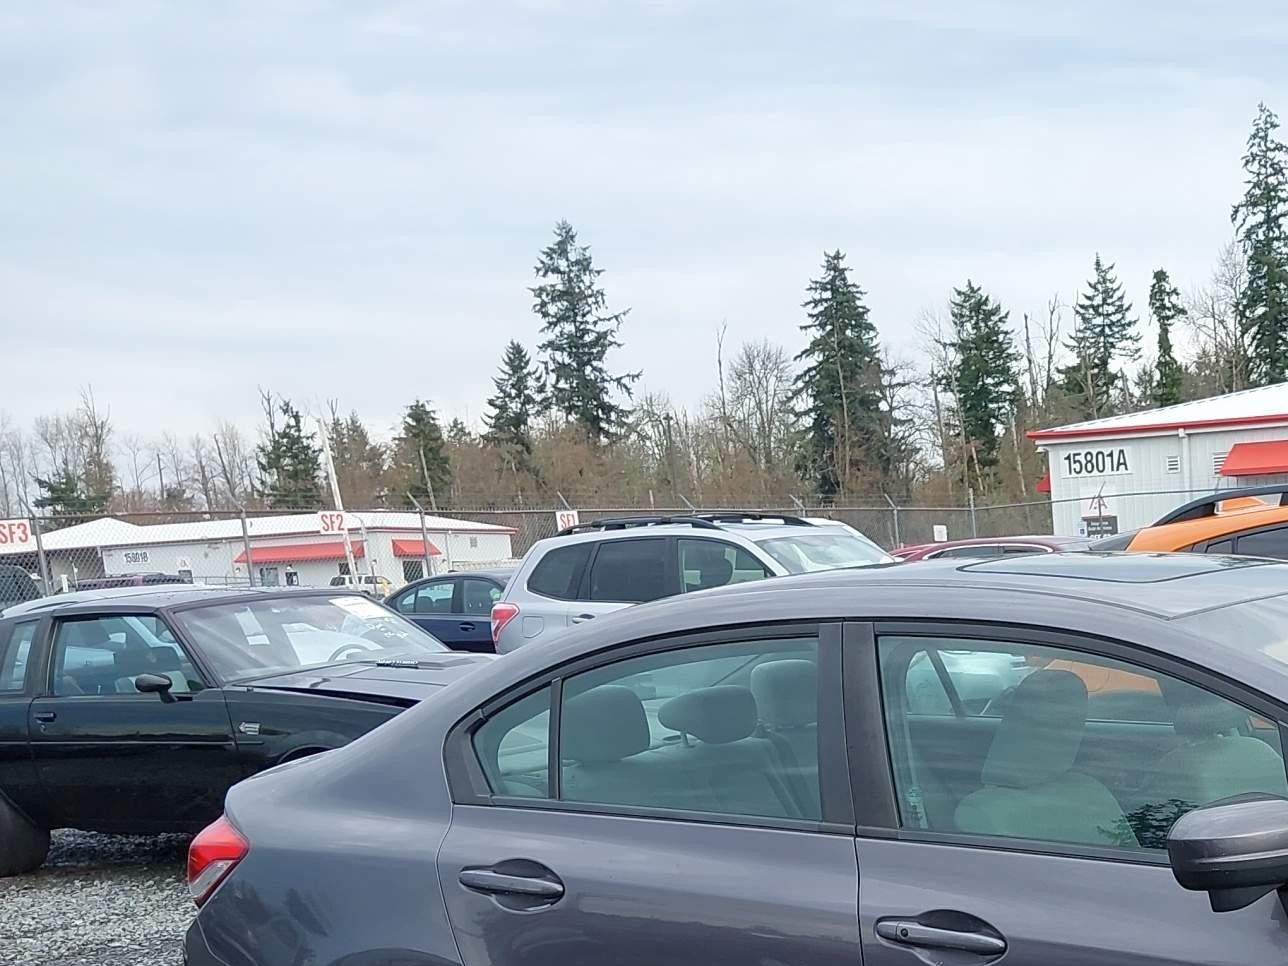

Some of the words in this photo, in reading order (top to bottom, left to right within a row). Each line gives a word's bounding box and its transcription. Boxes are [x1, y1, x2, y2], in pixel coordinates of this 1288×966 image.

[1063, 448, 1129, 475] 15801A
[320, 513, 345, 532] SF2
[560, 513, 575, 529] SF1
[0, 522, 28, 544] SF3
